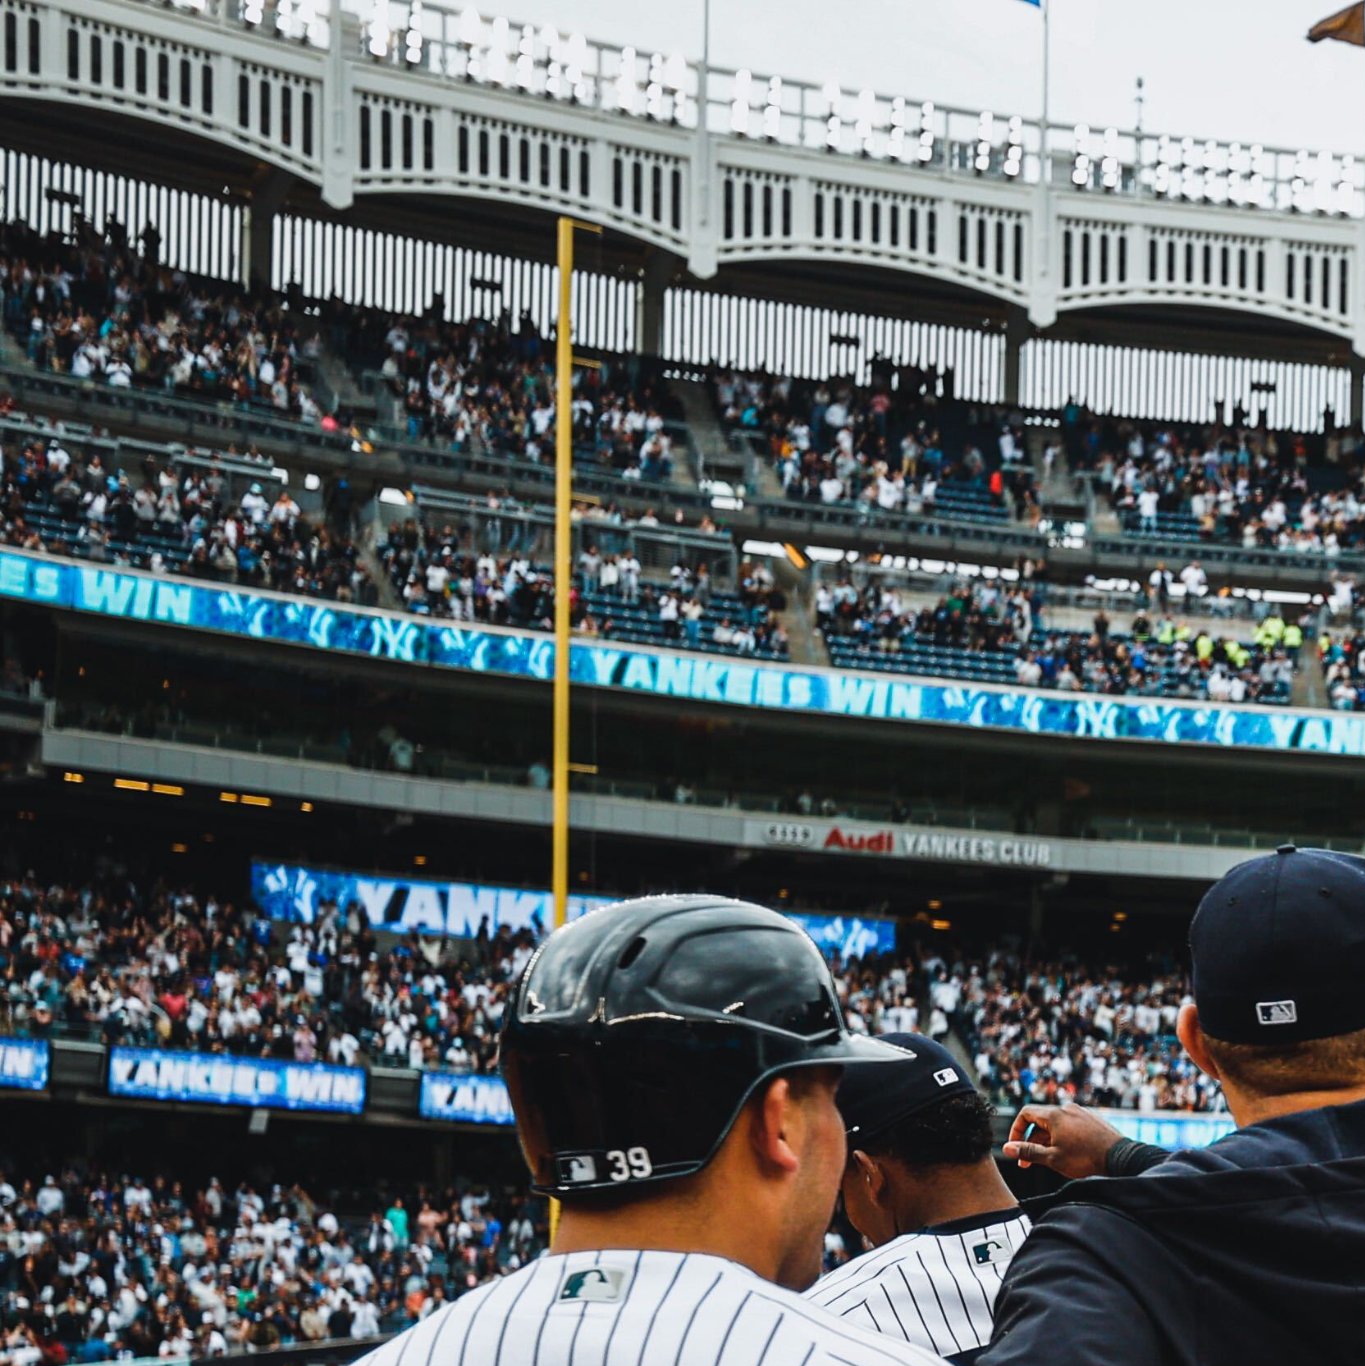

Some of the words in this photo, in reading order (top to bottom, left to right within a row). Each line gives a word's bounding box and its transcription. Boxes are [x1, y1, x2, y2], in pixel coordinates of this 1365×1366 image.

[82, 568, 192, 625] WIN
[592, 650, 811, 707] YANKEES
[828, 675, 922, 719] WIN
[823, 827, 895, 854] Audi
[904, 833, 994, 861] YANKEES
[999, 843, 1050, 865] CLUB
[112, 1057, 279, 1097] YANKEES
[284, 1066, 361, 1105] WIN
[606, 1146, 653, 1182] 39
